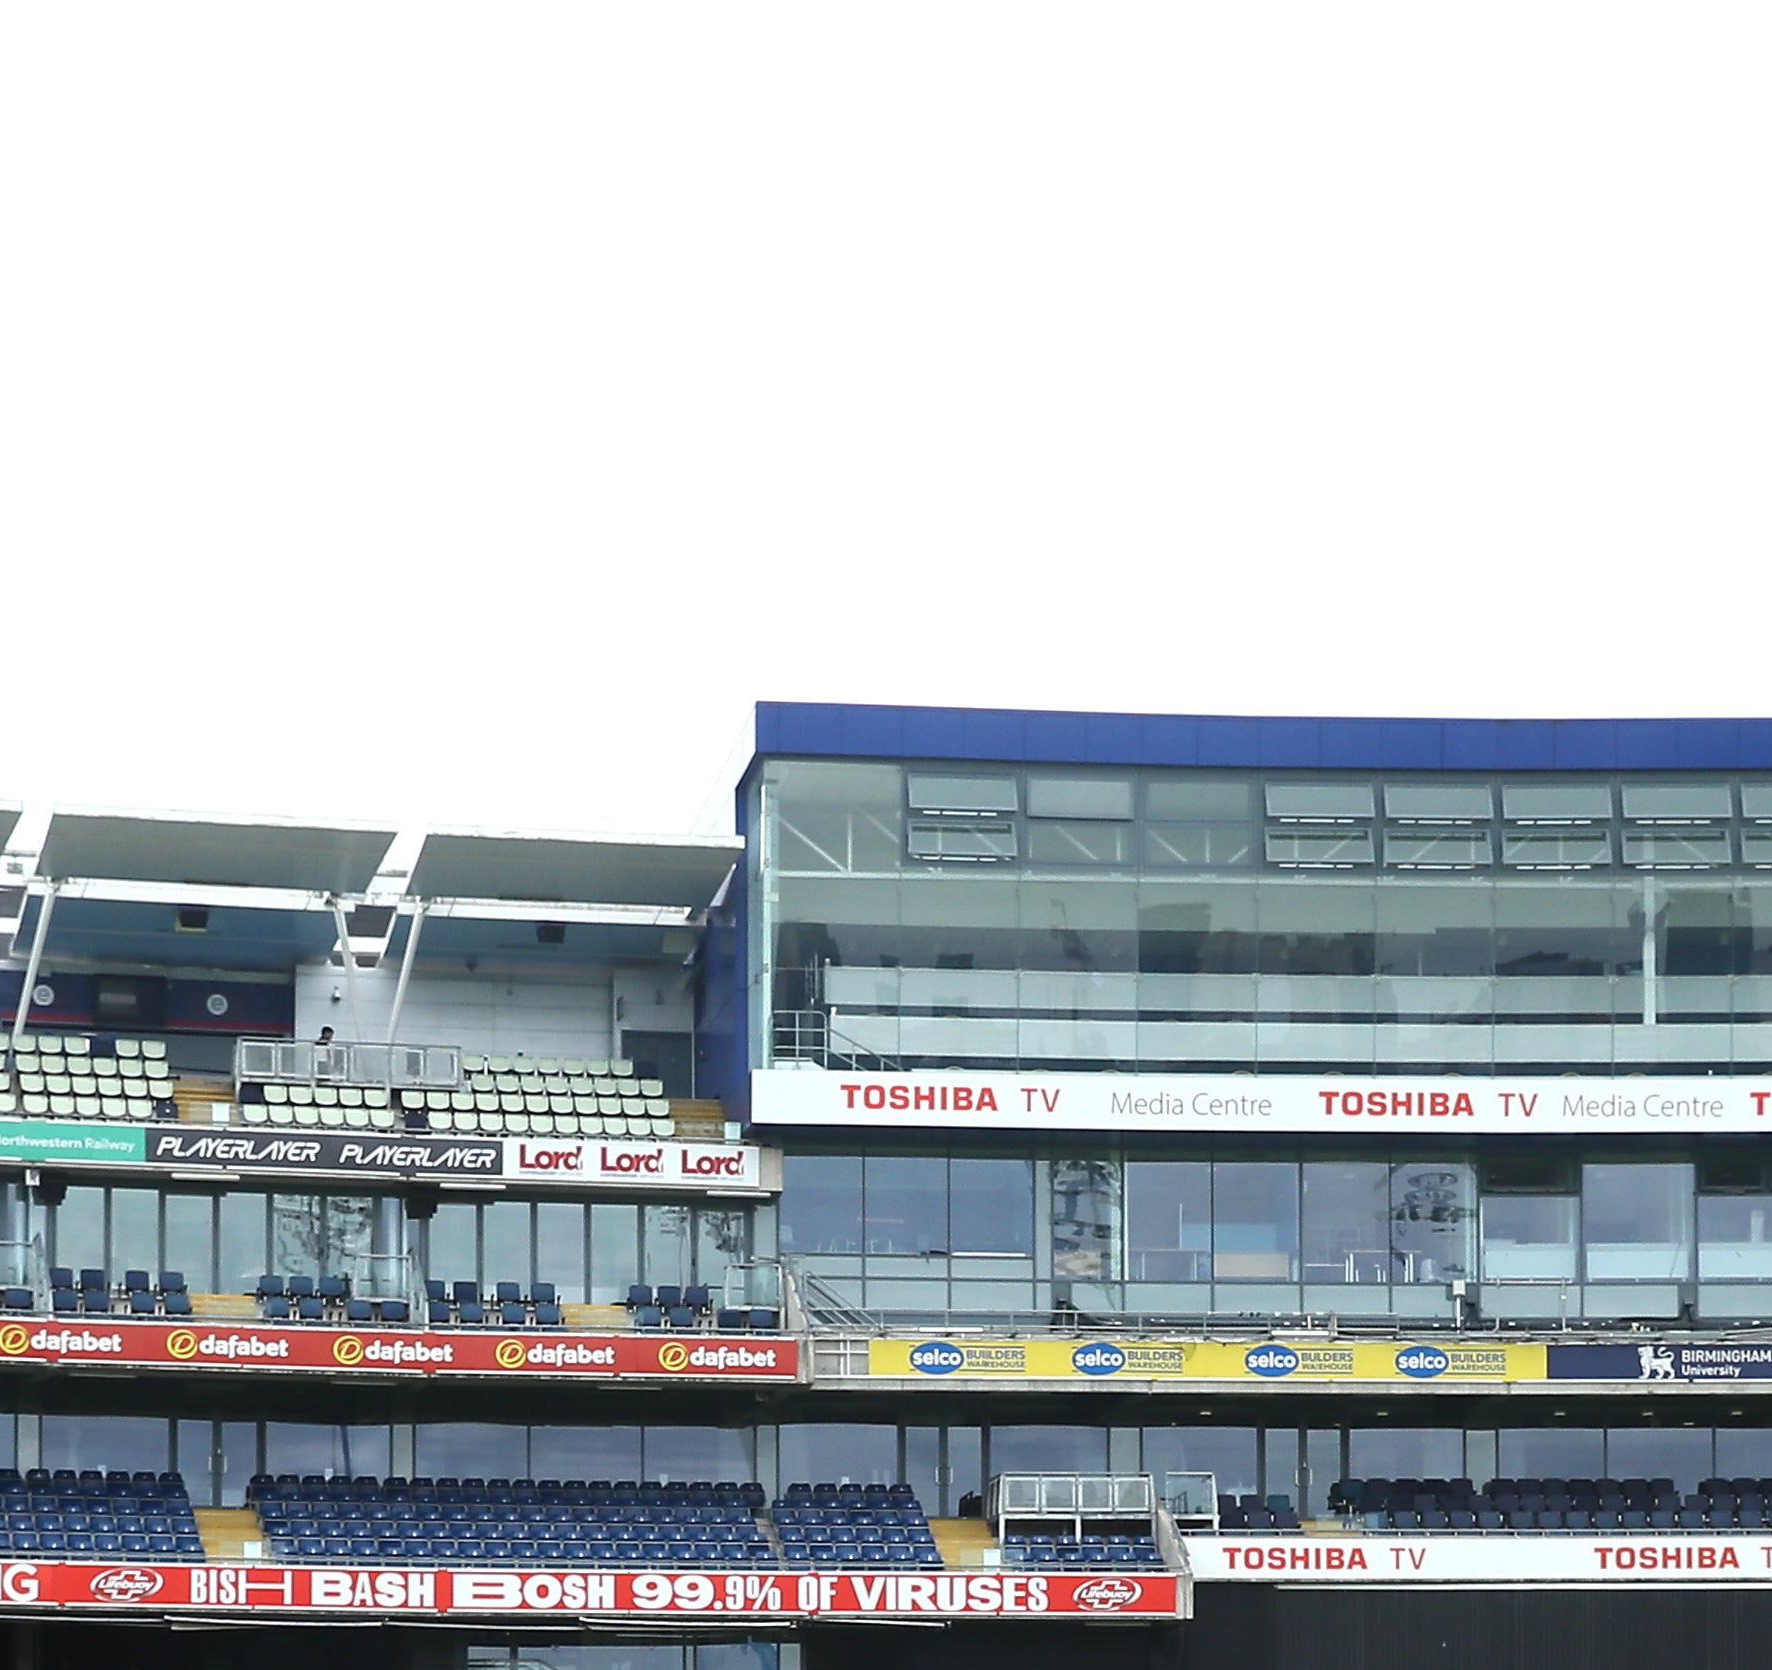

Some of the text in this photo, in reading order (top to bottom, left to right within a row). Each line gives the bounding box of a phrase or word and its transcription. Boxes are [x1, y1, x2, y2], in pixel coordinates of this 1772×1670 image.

[840, 1084, 1272, 1116] TOSHIBA TV Media Centre
[1319, 1091, 1723, 1118] TOSHIBA TV Media Centre
[85, 1138, 135, 1153] Railway
[155, 1136, 321, 1162] PLAYERLAYER
[339, 1144, 497, 1169] PLAYERLAYER
[30, 1328, 123, 1355] dafabet
[198, 1333, 290, 1359] dafabet
[363, 1338, 454, 1364] dafabet
[526, 1341, 616, 1368] dafabet
[687, 1345, 778, 1370] dafabet
[912, 1350, 962, 1367] selco
[1074, 1351, 1124, 1368] selco
[1248, 1353, 1296, 1369] selco
[1397, 1353, 1447, 1370] selco
[1450, 1353, 1506, 1363] BUILDERS
[1682, 1350, 1772, 1363] BIRMINGHAM
[1682, 1364, 1741, 1377] University
[1222, 1546, 1426, 1570] TOSHIBA TV
[1595, 1546, 1740, 1570] TOSHIBA
[99, 1577, 155, 1592] Lifebuoy
[191, 1568, 1050, 1613] BISH BASH BOSH 99.9% OF VIRUSES
[1079, 1586, 1135, 1600] Lifebuoy
